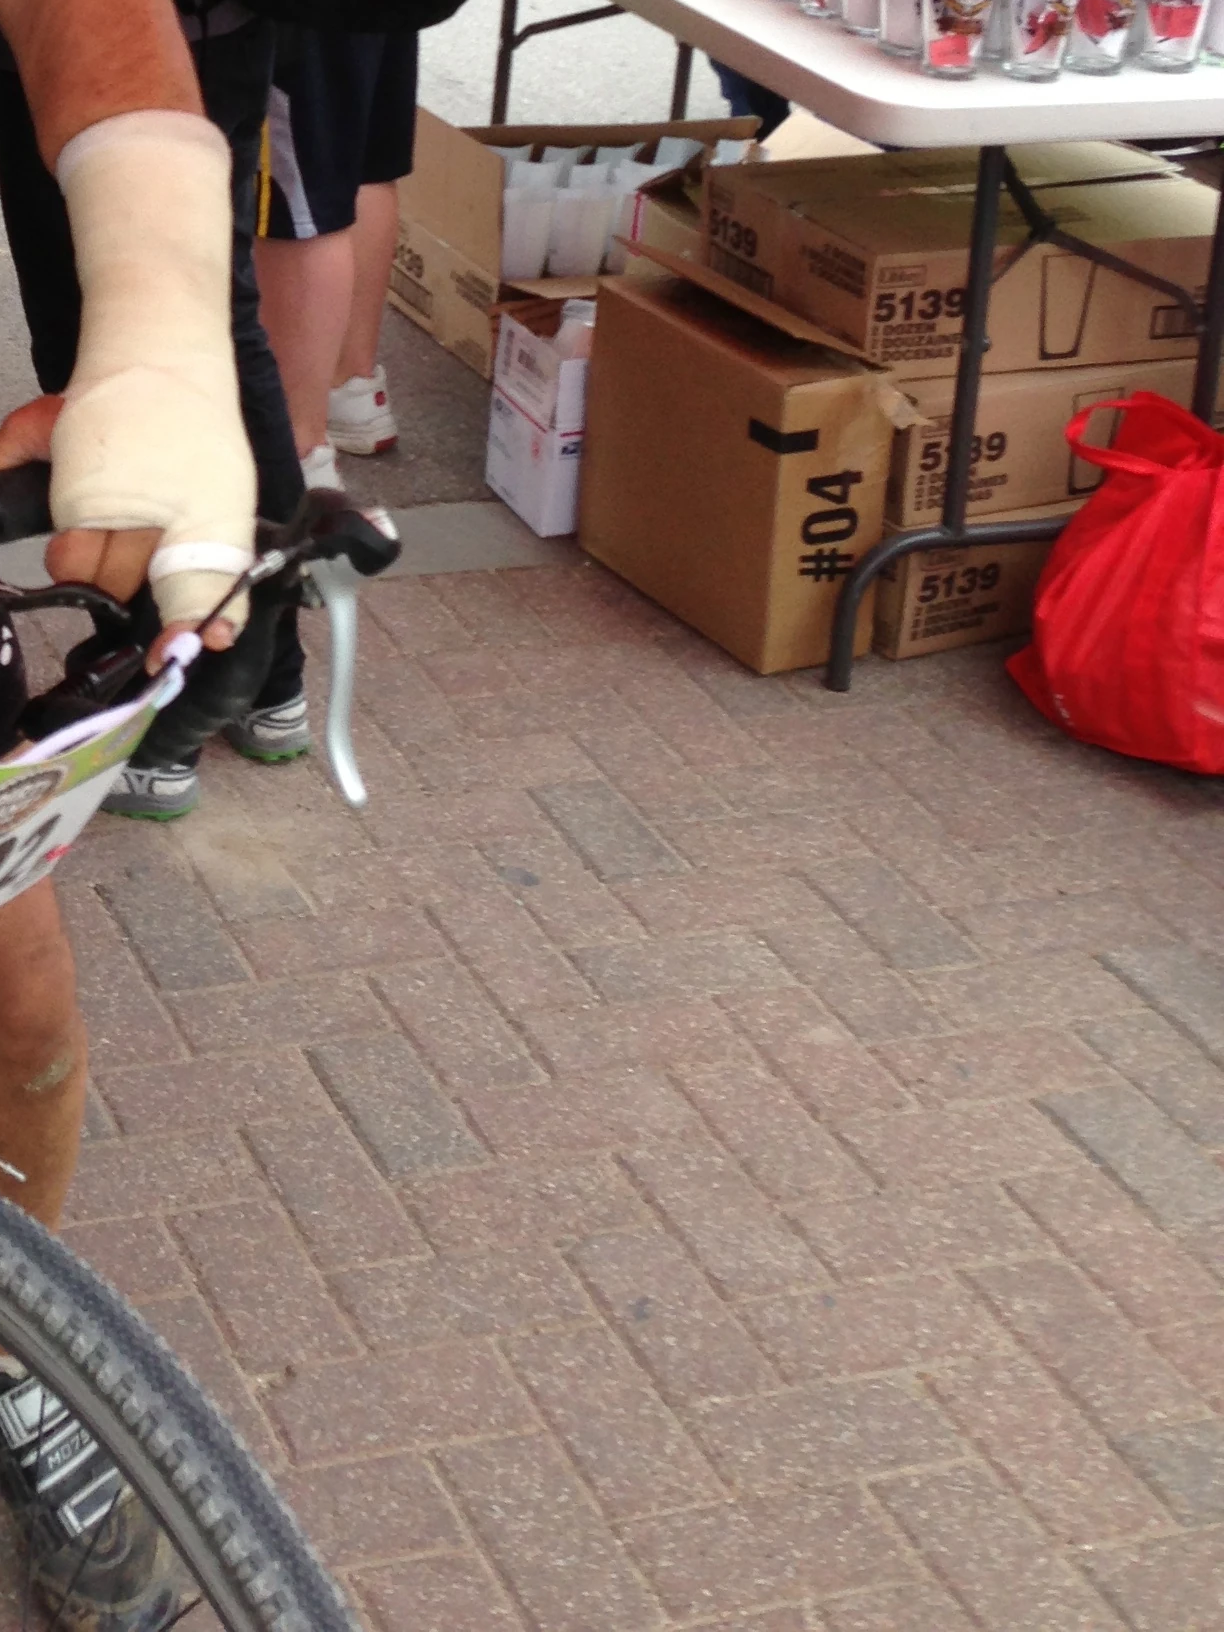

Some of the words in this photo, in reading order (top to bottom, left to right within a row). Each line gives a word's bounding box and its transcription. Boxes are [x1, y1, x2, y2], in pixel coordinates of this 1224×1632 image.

[710, 208, 758, 258] 5139
[875, 287, 966, 322] 5139
[882, 332, 963, 347] DOUZAINE
[920, 431, 1007, 472] 539
[798, 469, 863, 582] #04
[919, 563, 1000, 603] 5139
